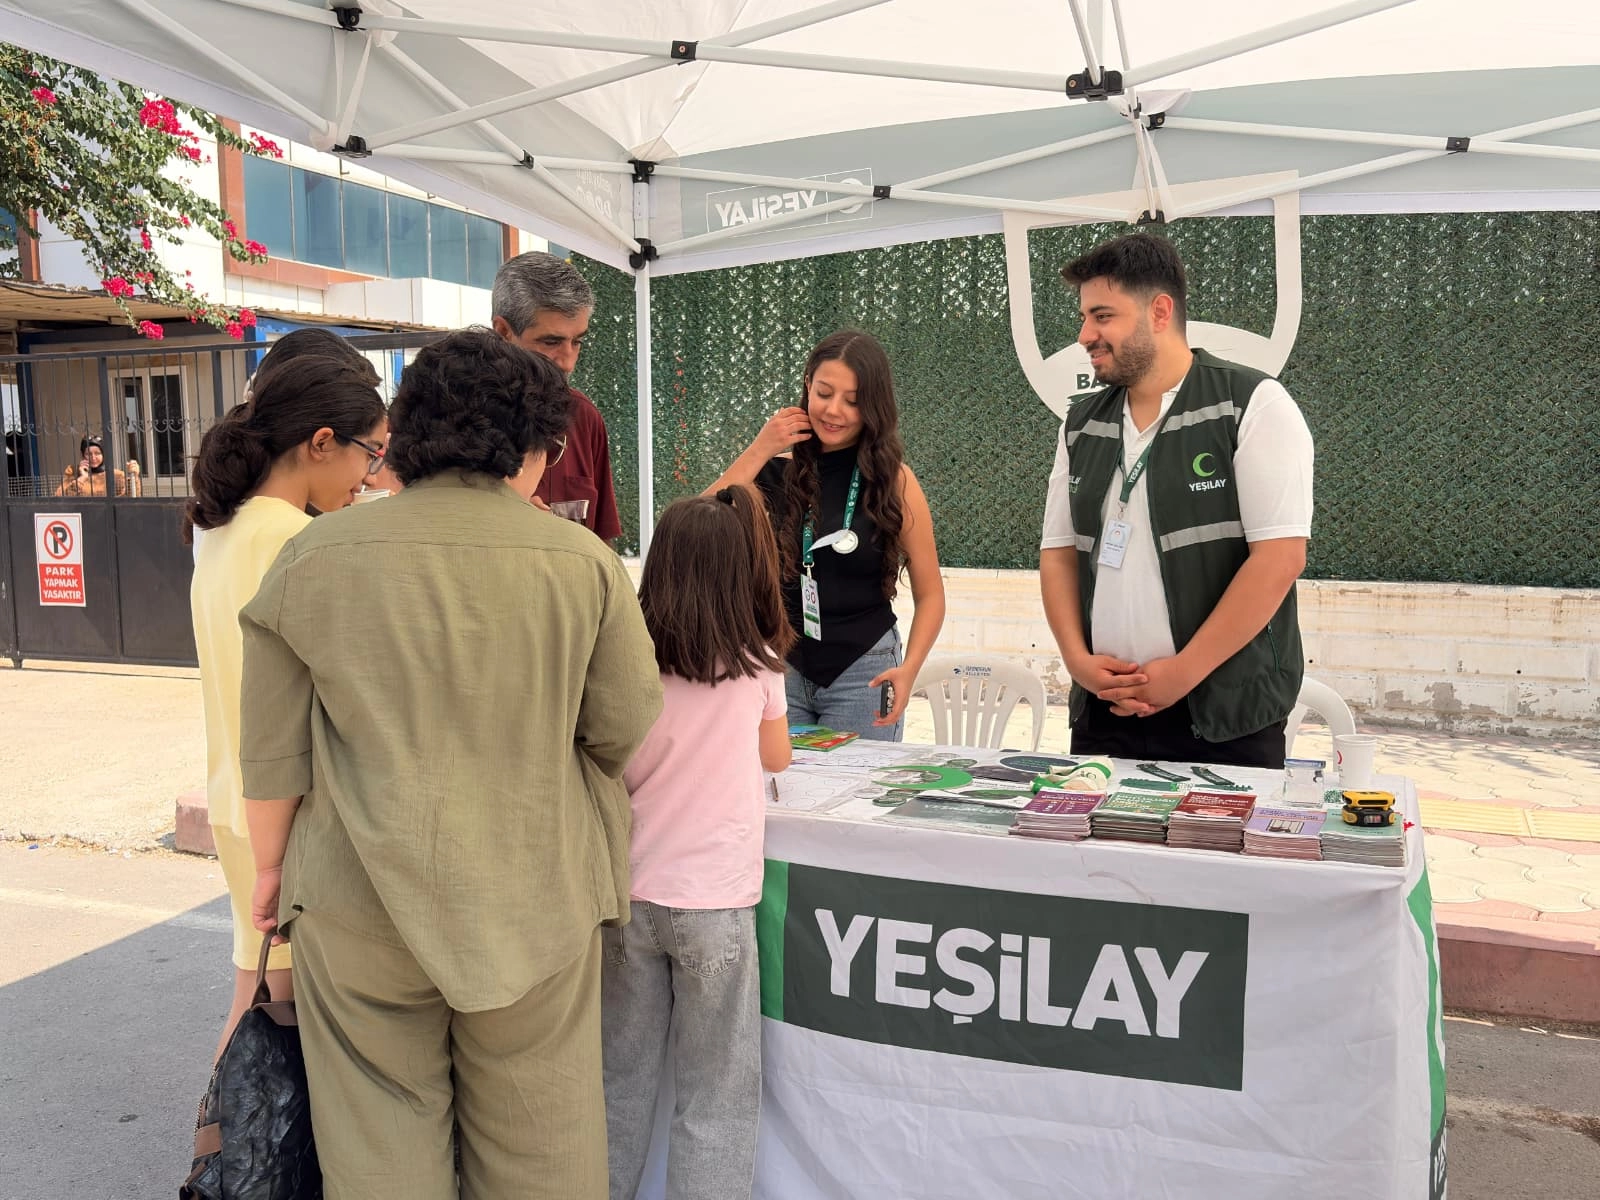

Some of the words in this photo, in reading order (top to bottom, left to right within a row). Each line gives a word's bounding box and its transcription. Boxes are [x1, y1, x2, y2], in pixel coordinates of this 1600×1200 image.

[1188, 478, 1227, 492] YEŞİLAY
[45, 566, 75, 576] PARK
[44, 578, 78, 588] YAPMAK
[43, 590, 82, 600] YASAKTIR
[814, 908, 1210, 1040] YEŞİLAY
